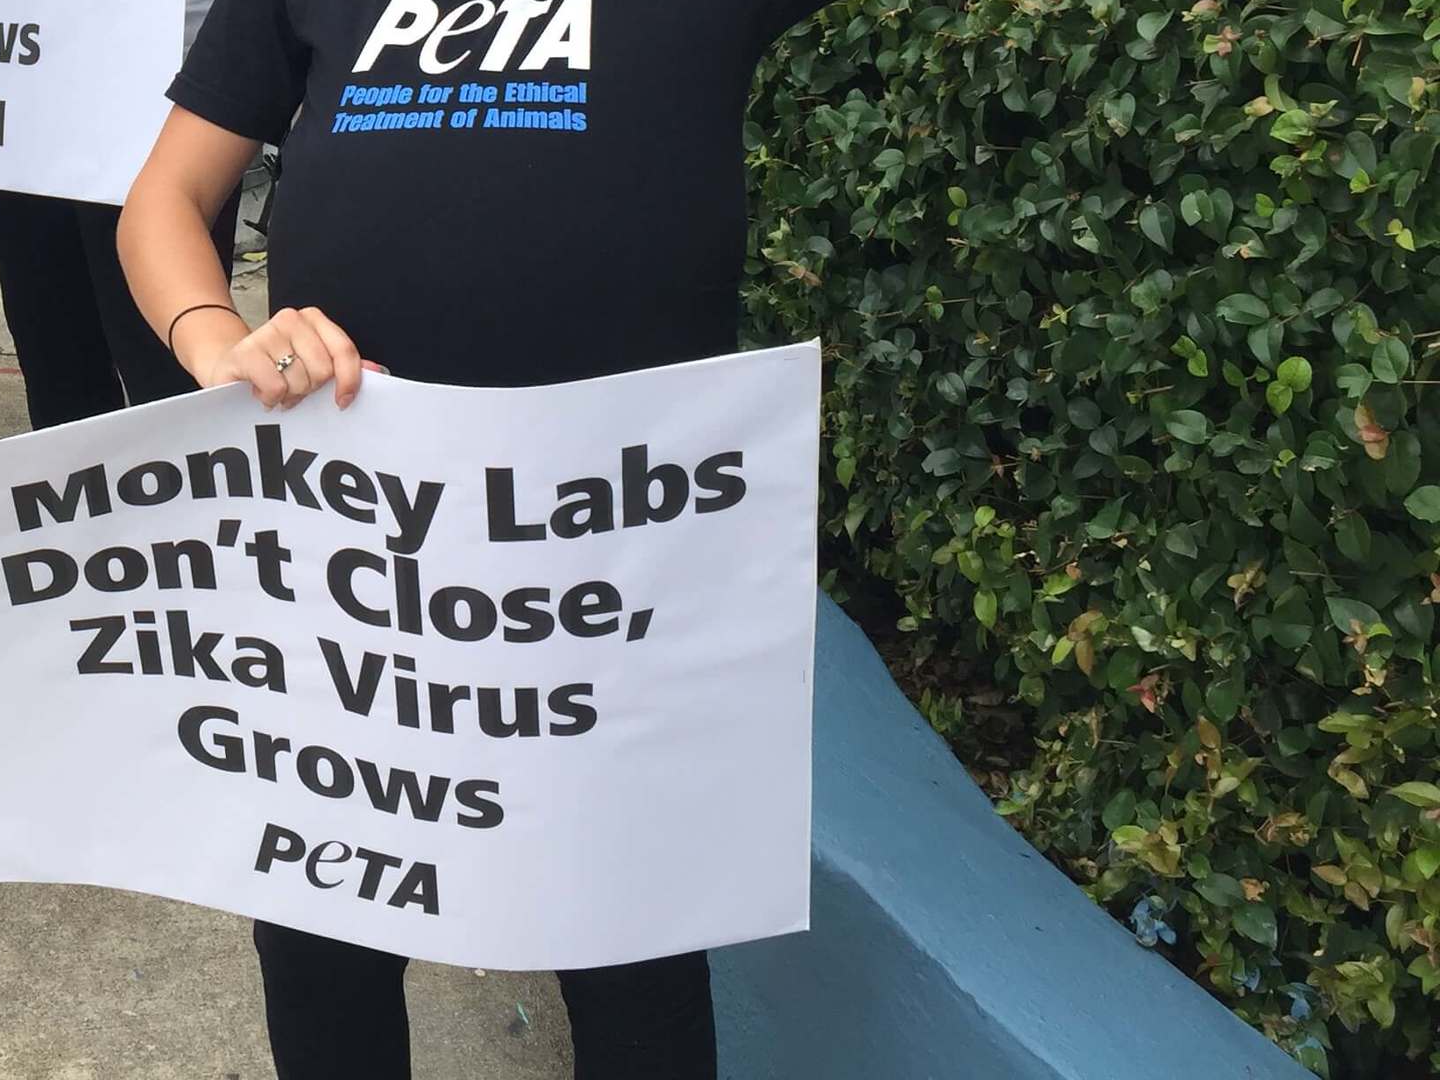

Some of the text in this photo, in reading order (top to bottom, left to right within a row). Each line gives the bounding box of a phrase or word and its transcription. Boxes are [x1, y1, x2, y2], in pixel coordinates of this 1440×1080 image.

[332, 108, 587, 133] Treatment of Animals
[340, 82, 587, 106] People for the Ethical
[11, 423, 445, 555] Monkey
[486, 444, 747, 542] Labs
[327, 549, 655, 644] Close,
[70, 610, 598, 738] Zika Virus
[177, 705, 505, 830] Grows
